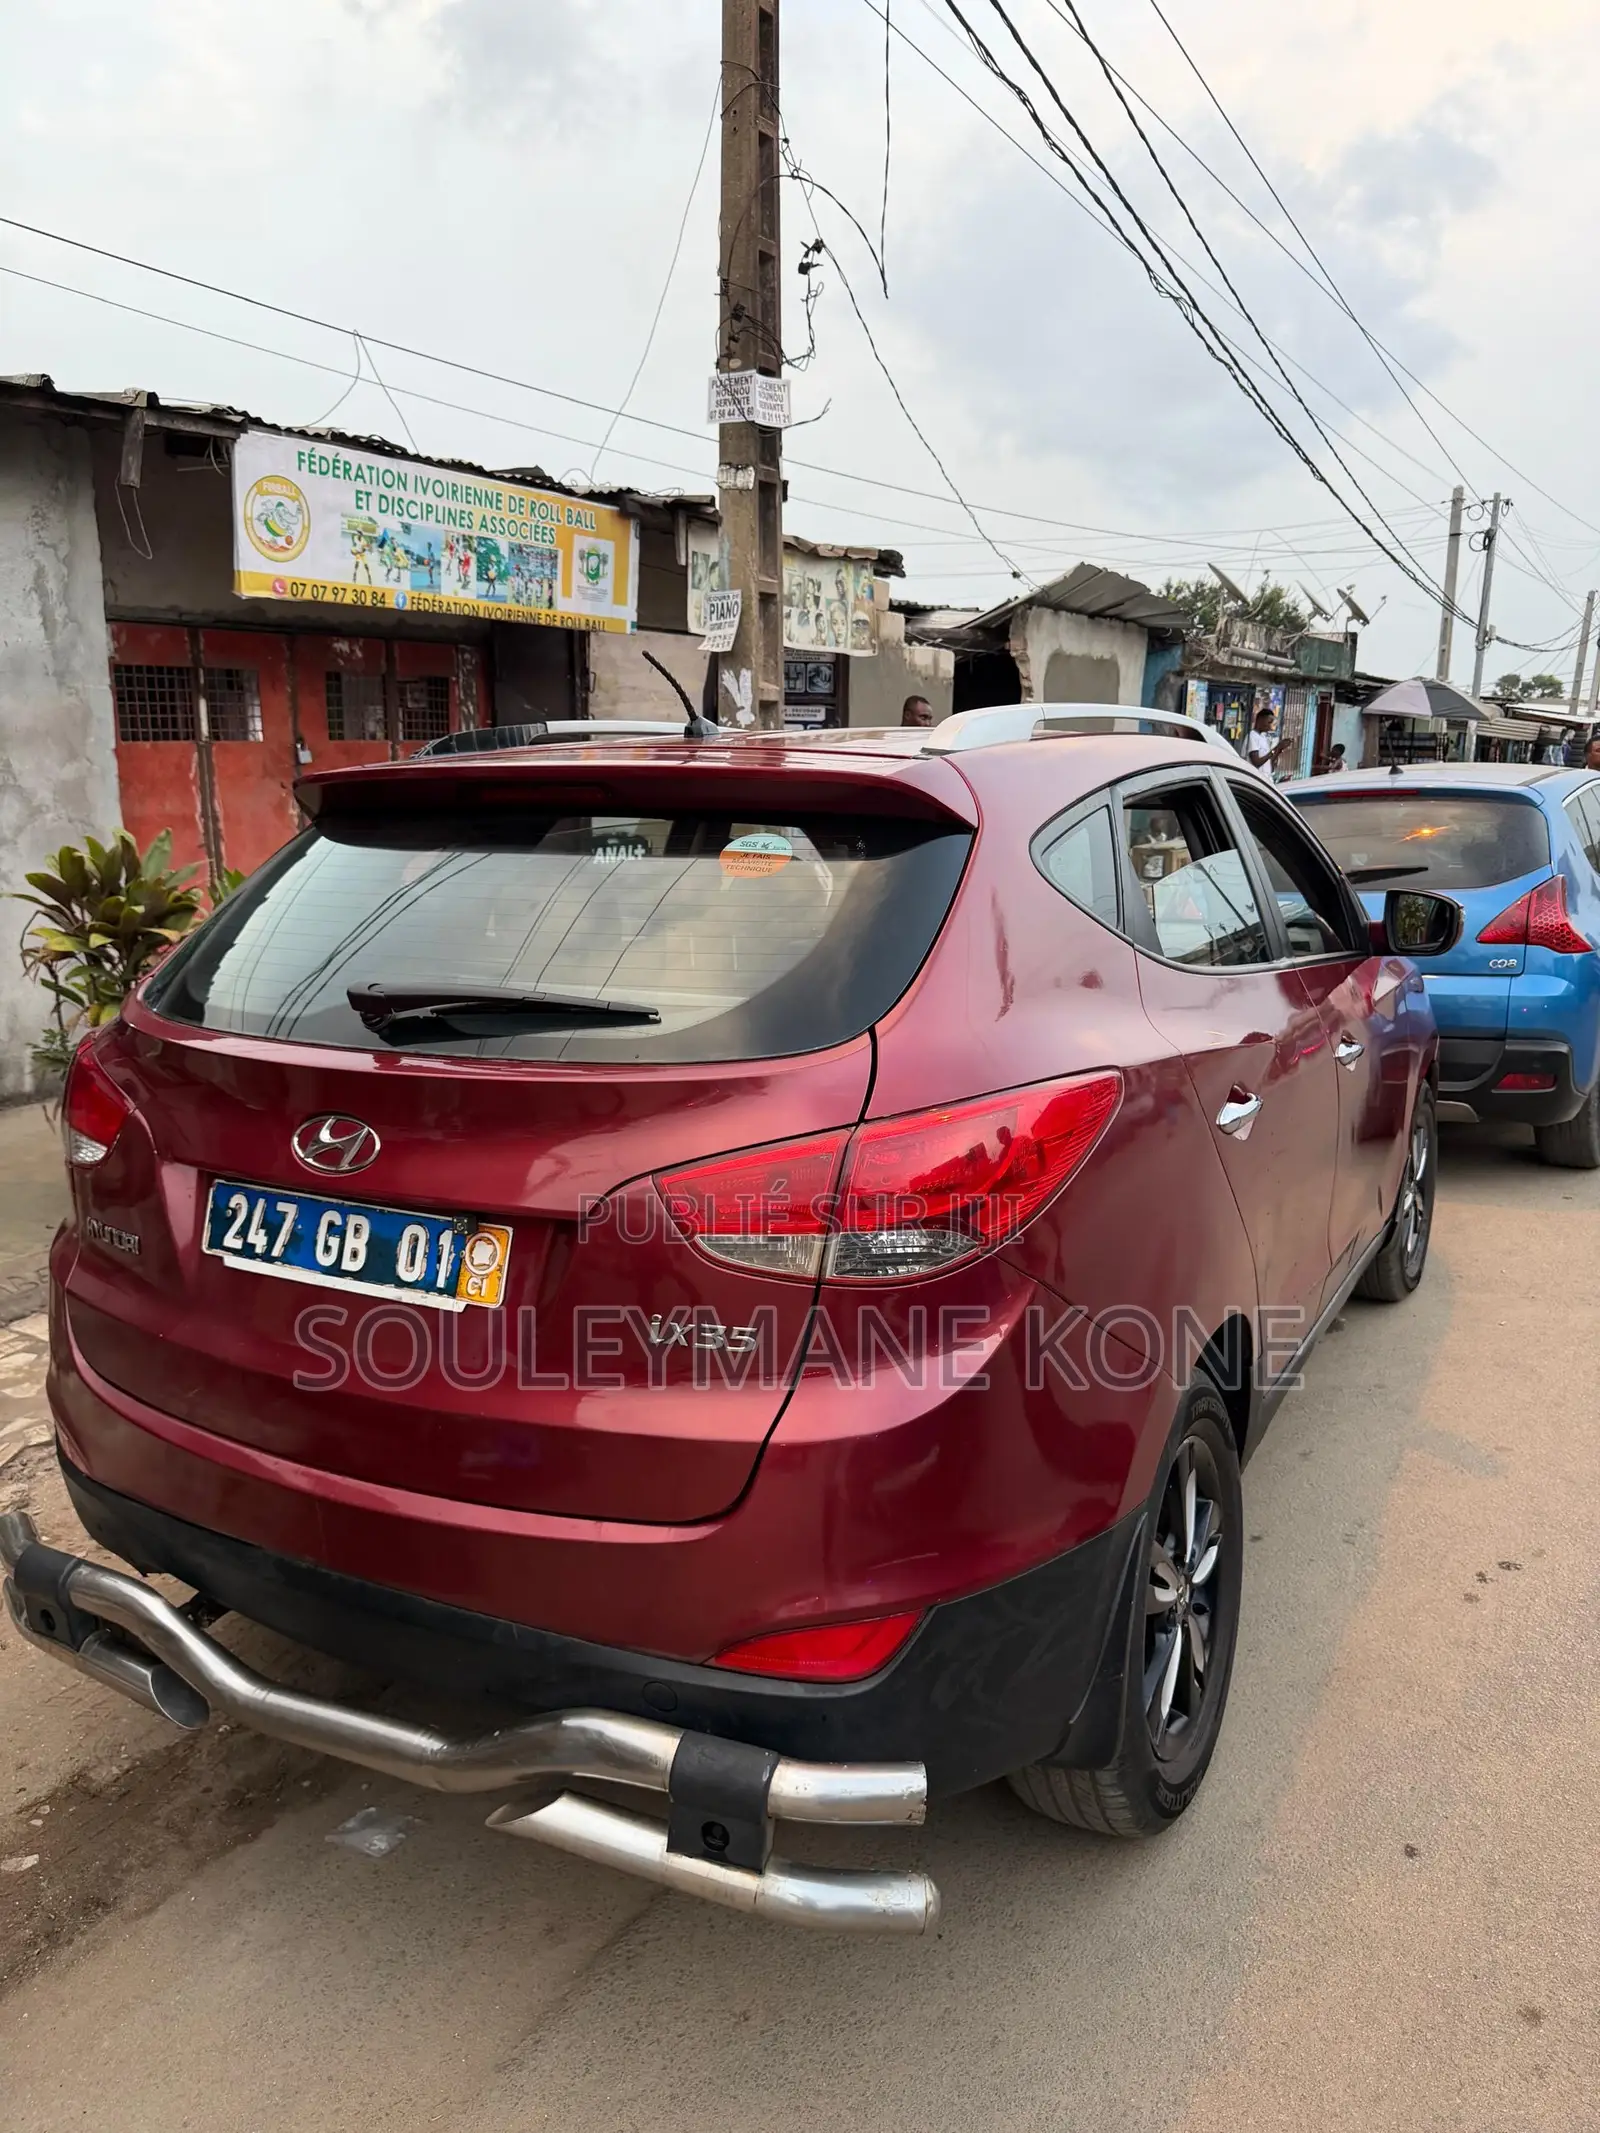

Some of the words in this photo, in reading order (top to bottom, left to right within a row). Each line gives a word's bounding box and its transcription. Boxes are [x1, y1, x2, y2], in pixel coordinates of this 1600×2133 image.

[711, 375, 753, 389] PLACEMENT
[296, 447, 408, 492] FÉDÉRATION
[414, 474, 503, 511] IVOIRIENNE
[508, 495, 525, 516] DE
[530, 500, 562, 524] ROLL
[566, 508, 596, 530] BALL
[355, 489, 372, 511] ET
[378, 494, 474, 530] DISCIPLINES
[478, 514, 556, 545] ASSOCIÉES
[290, 582, 307, 598] 07
[311, 584, 327, 600] 07
[331, 587, 347, 602] 97
[351, 589, 367, 605] 30
[370, 591, 386, 607] 84
[411, 592, 480, 617] FÉDÉRATION
[483, 605, 542, 625] IVOIRIENNE
[545, 613, 557, 627] DE
[709, 600, 740, 621] PIANO
[740, 840, 759, 848] SGS
[726, 864, 773, 873] TECHNIQUE
[223, 1193, 299, 1258] 247
[315, 1210, 370, 1272] GB
[397, 1224, 454, 1288] 01
